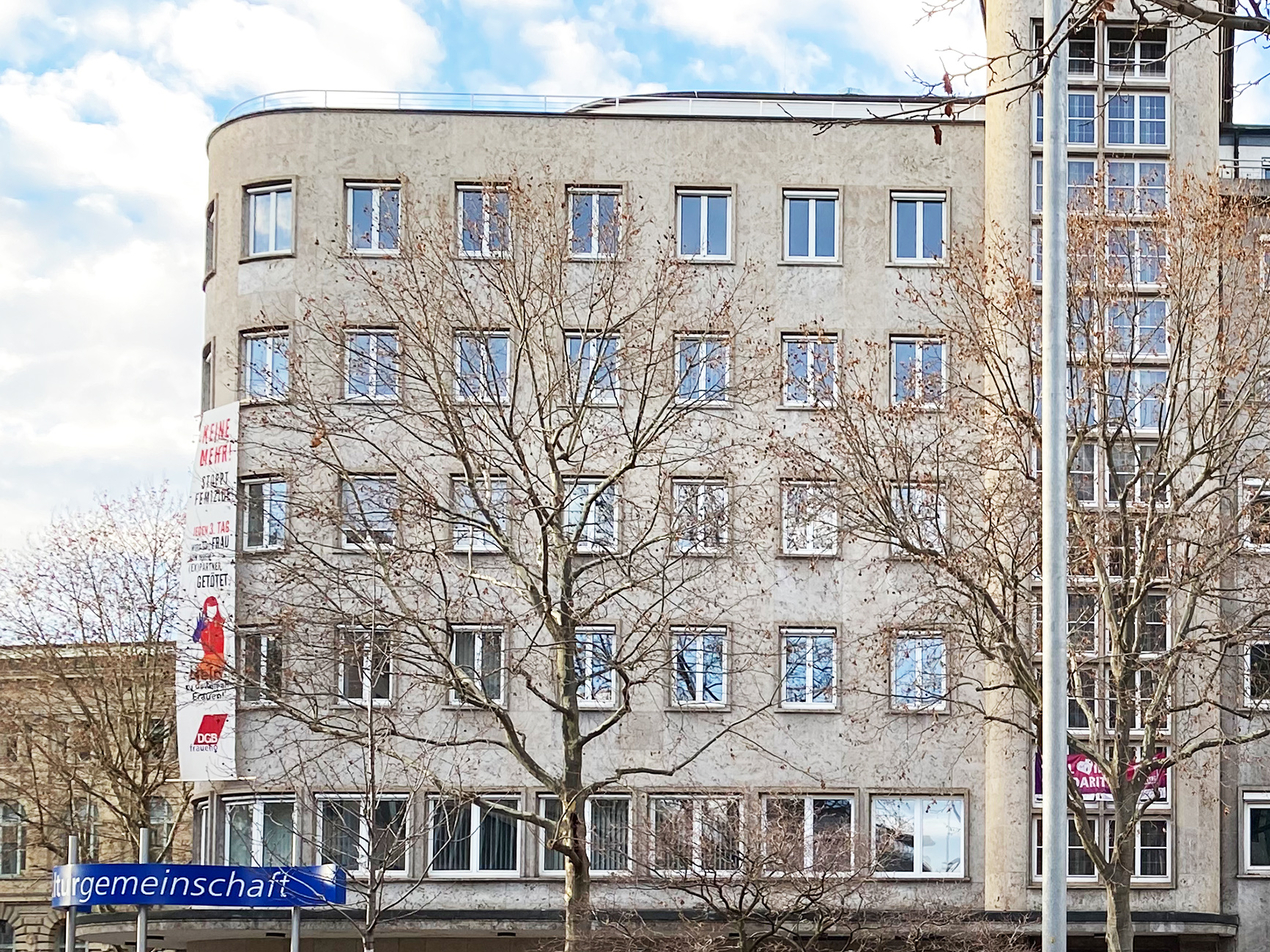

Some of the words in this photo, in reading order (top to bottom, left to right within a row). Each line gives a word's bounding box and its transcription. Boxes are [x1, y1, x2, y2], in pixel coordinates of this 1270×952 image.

[202, 418, 230, 444] KEINE
[200, 444, 232, 467] MEHR!
[218, 520, 230, 534] TAG
[212, 535, 229, 550] FRAU
[197, 733, 218, 743] DGB
